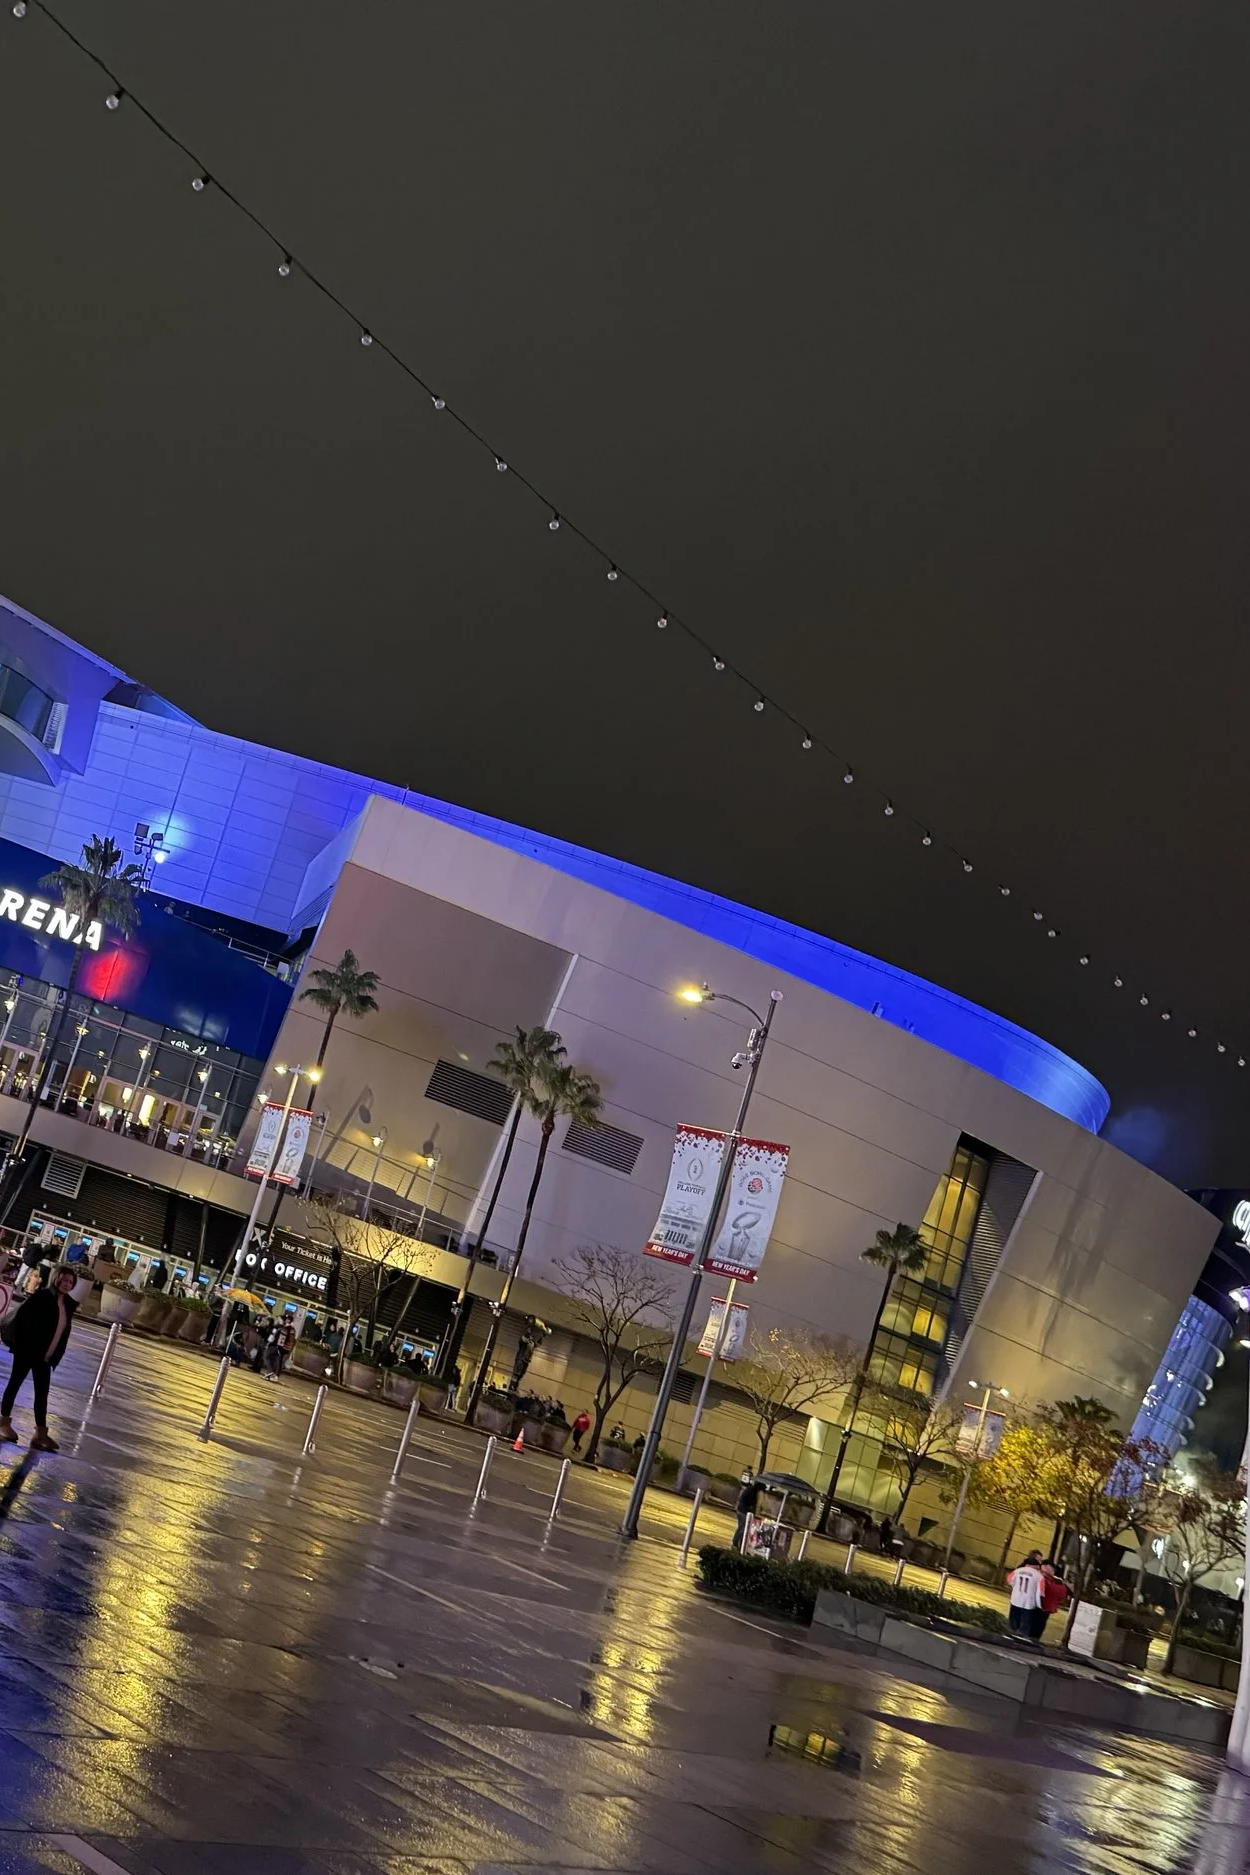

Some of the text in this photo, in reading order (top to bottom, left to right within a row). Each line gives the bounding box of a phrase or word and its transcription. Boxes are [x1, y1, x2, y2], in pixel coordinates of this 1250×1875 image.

[676, 1183, 707, 1196] PLAYOFF
[281, 1241, 297, 1253] Your
[296, 1246, 316, 1260] Ticket
[651, 1244, 689, 1260] NEW YEAR'S DAY
[274, 1262, 328, 1290] OFFICE
[712, 1260, 724, 1269] NEW
[723, 1264, 740, 1274] YEAR'S
[739, 1268, 751, 1276] DAY
